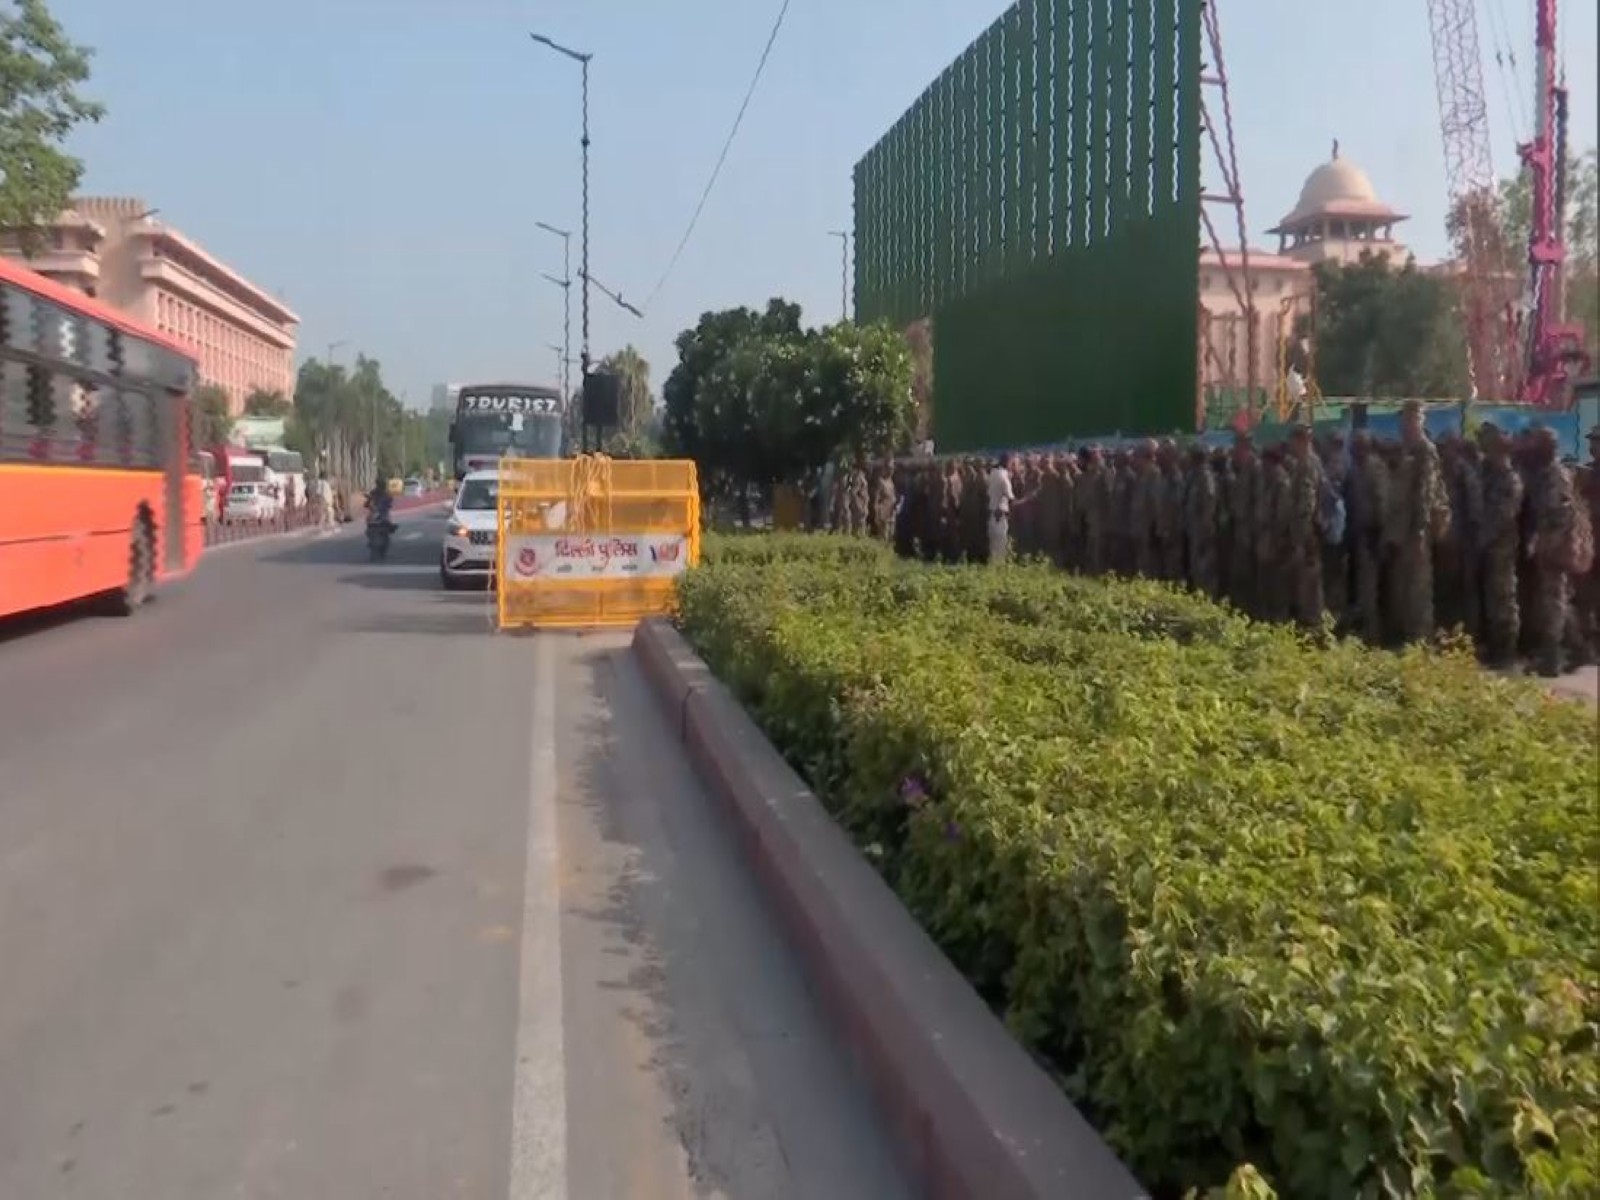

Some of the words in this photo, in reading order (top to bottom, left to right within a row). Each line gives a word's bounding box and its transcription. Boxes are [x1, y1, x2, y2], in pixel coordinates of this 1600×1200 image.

[465, 396, 556, 412] TOURIST
[555, 538, 595, 558] दिल्ली
[597, 538, 639, 563] पुलिस
